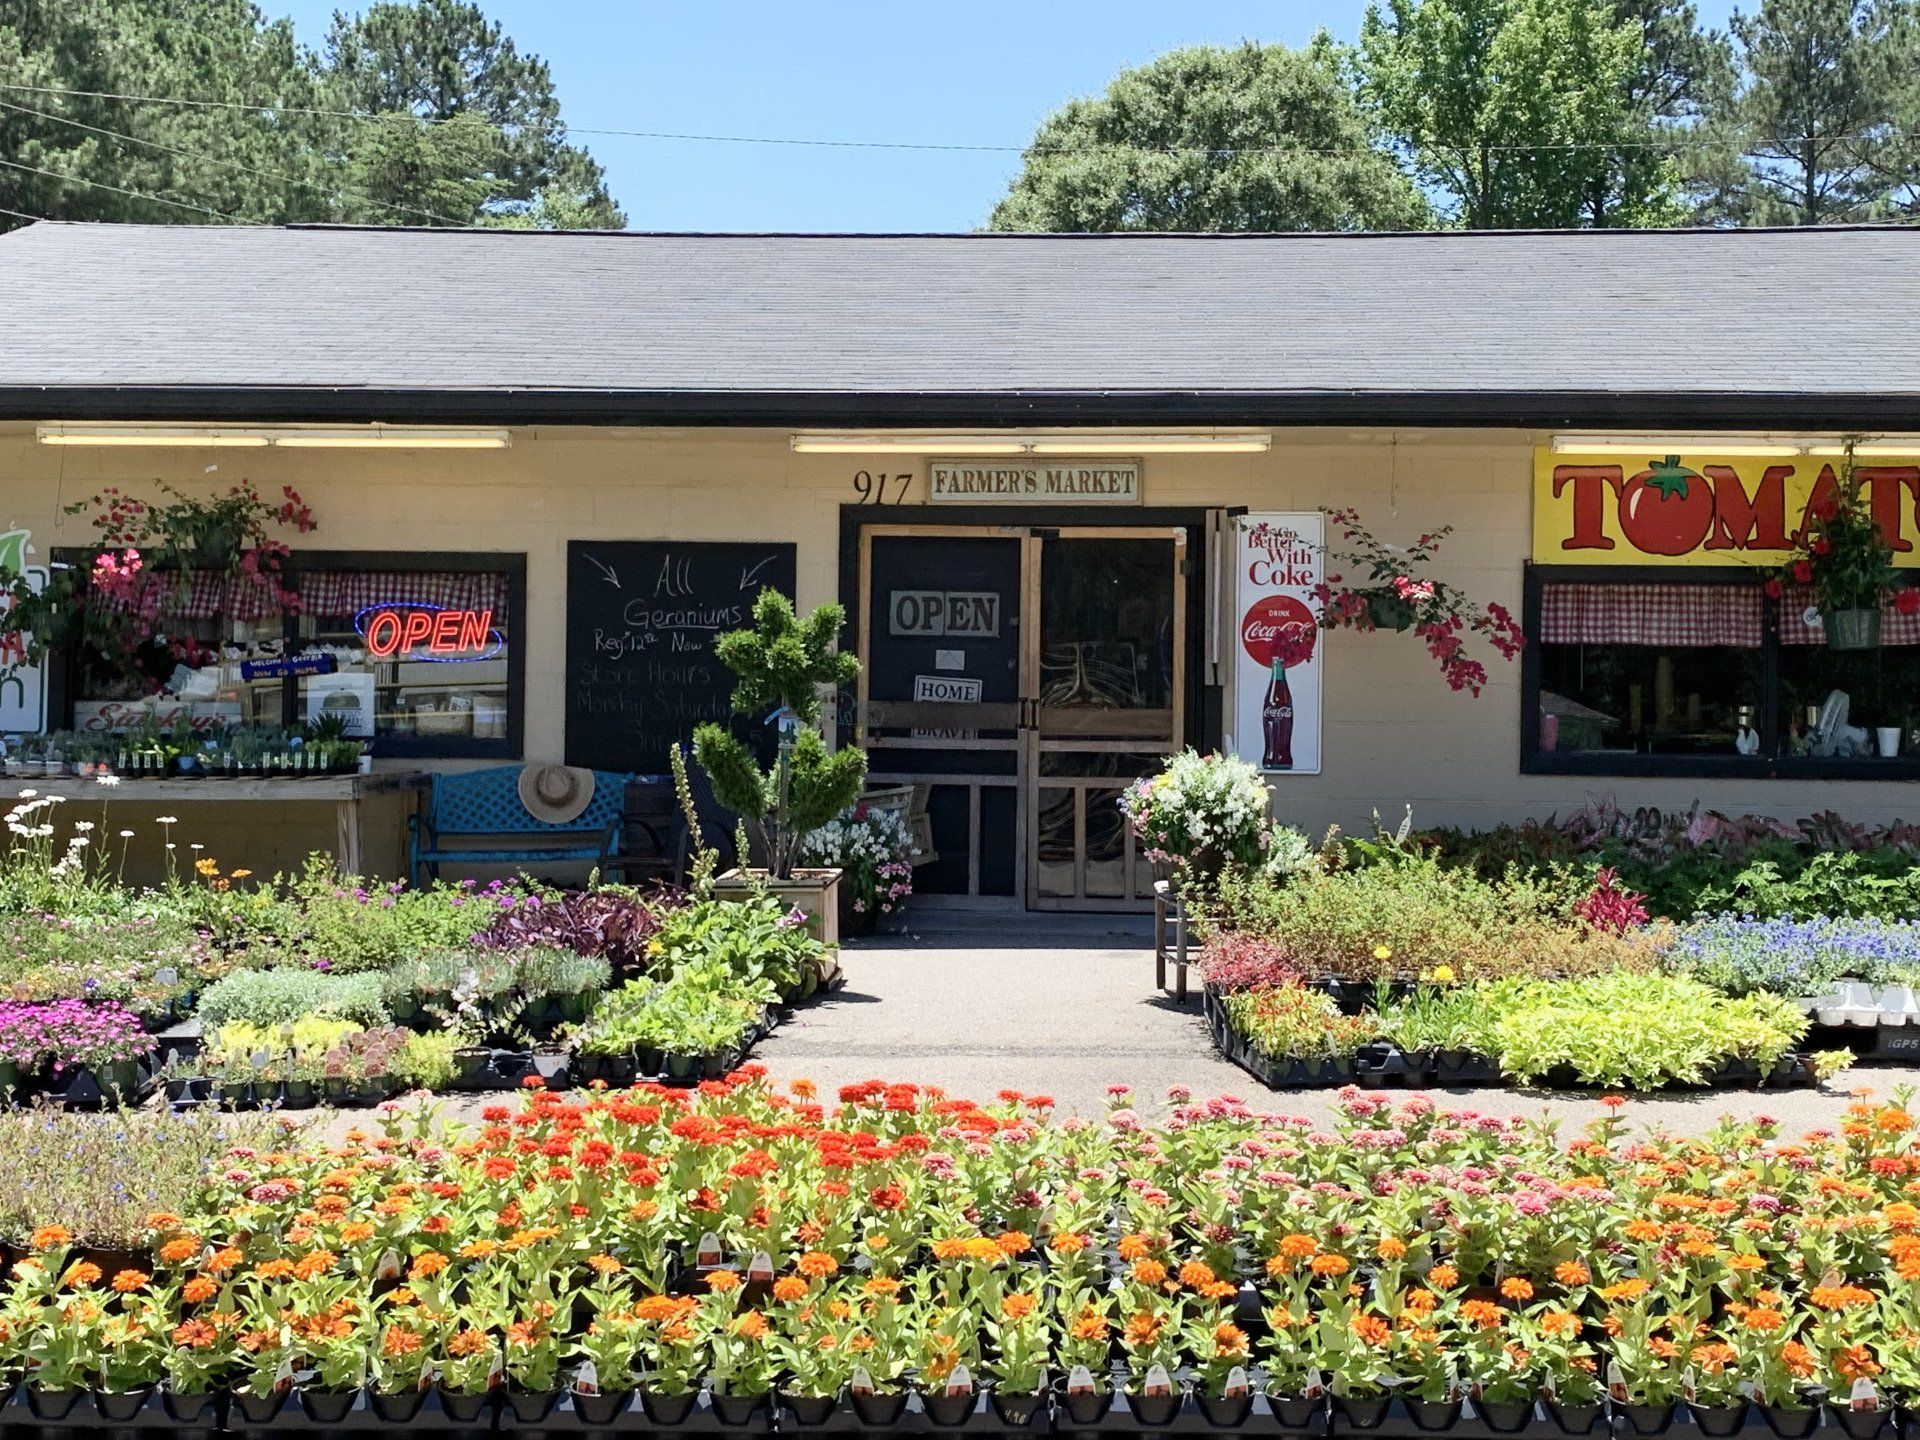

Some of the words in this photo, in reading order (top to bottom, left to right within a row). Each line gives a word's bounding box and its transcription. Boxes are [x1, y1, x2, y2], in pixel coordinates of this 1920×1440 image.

[853, 470, 913, 505] 917
[934, 470, 1037, 494] FARMER'S
[1045, 470, 1135, 494] MARKET
[1553, 463, 1920, 556] TOMAT
[1267, 548, 1312, 565] With
[653, 554, 693, 597] All
[1249, 560, 1314, 586] Coke
[624, 599, 742, 631] Geraniums
[896, 595, 996, 632] OPEN
[1268, 609, 1290, 617] DRINK
[368, 611, 491, 656] OPEN
[671, 632, 702, 652] Now
[1244, 620, 1313, 643] Coca-Cl
[920, 682, 975, 700] HOME
